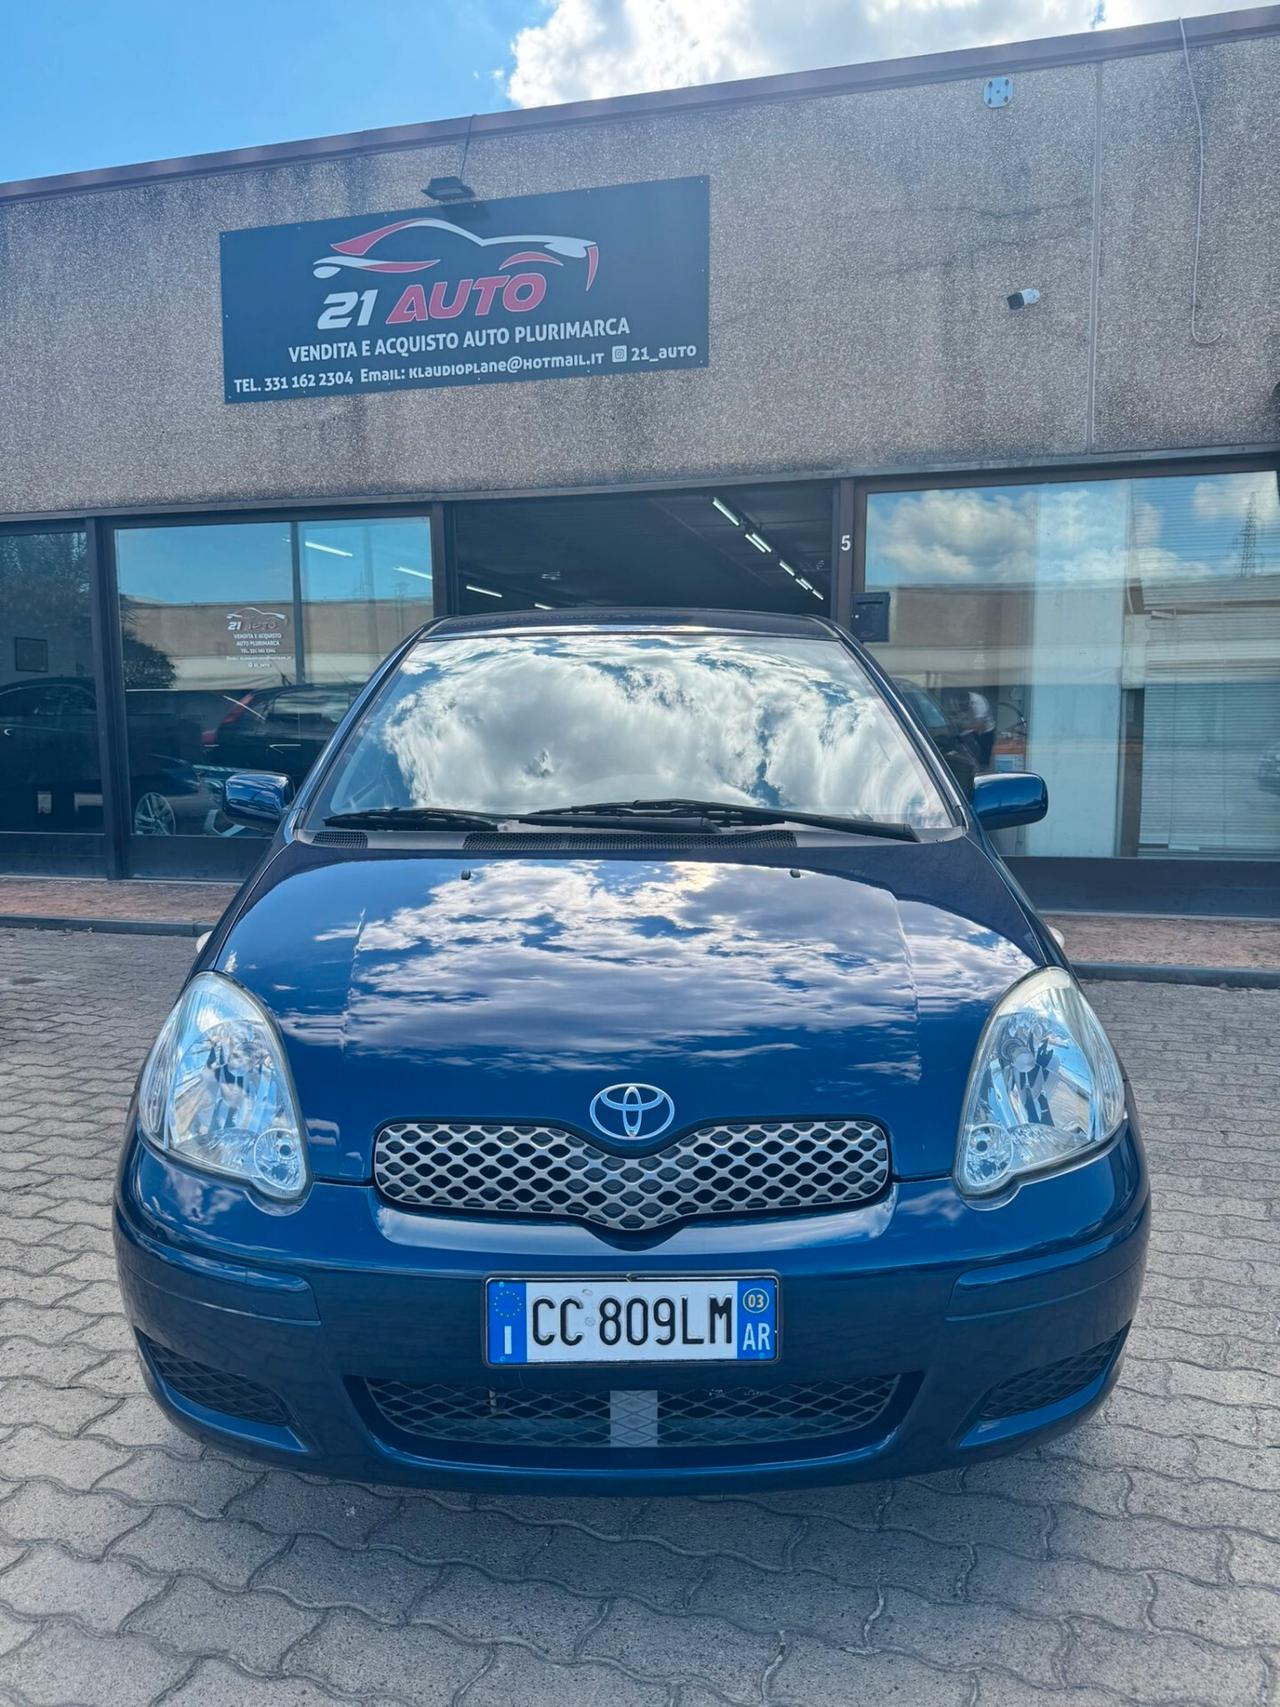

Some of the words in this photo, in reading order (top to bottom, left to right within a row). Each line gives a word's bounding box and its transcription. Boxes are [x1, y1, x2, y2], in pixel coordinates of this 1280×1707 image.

[317, 289, 378, 330] 21
[385, 272, 547, 325] AUTO
[288, 341, 358, 362] VENDITA
[362, 340, 371, 356] E
[374, 332, 459, 357] ACQUISTO
[463, 328, 510, 348] AUTO
[515, 317, 631, 343] PLURIMARCA
[234, 378, 261, 392] TEL.
[264, 376, 289, 391] 331
[291, 374, 316, 388] 162
[319, 371, 354, 386] 2304
[841, 534, 852, 551] 5
[227, 621, 242, 631] 21
[532, 1297, 584, 1346] CC
[599, 1295, 733, 1346] 809LM
[748, 1293, 764, 1308] 03
[504, 1325, 512, 1354] I
[743, 1322, 771, 1351] AR
